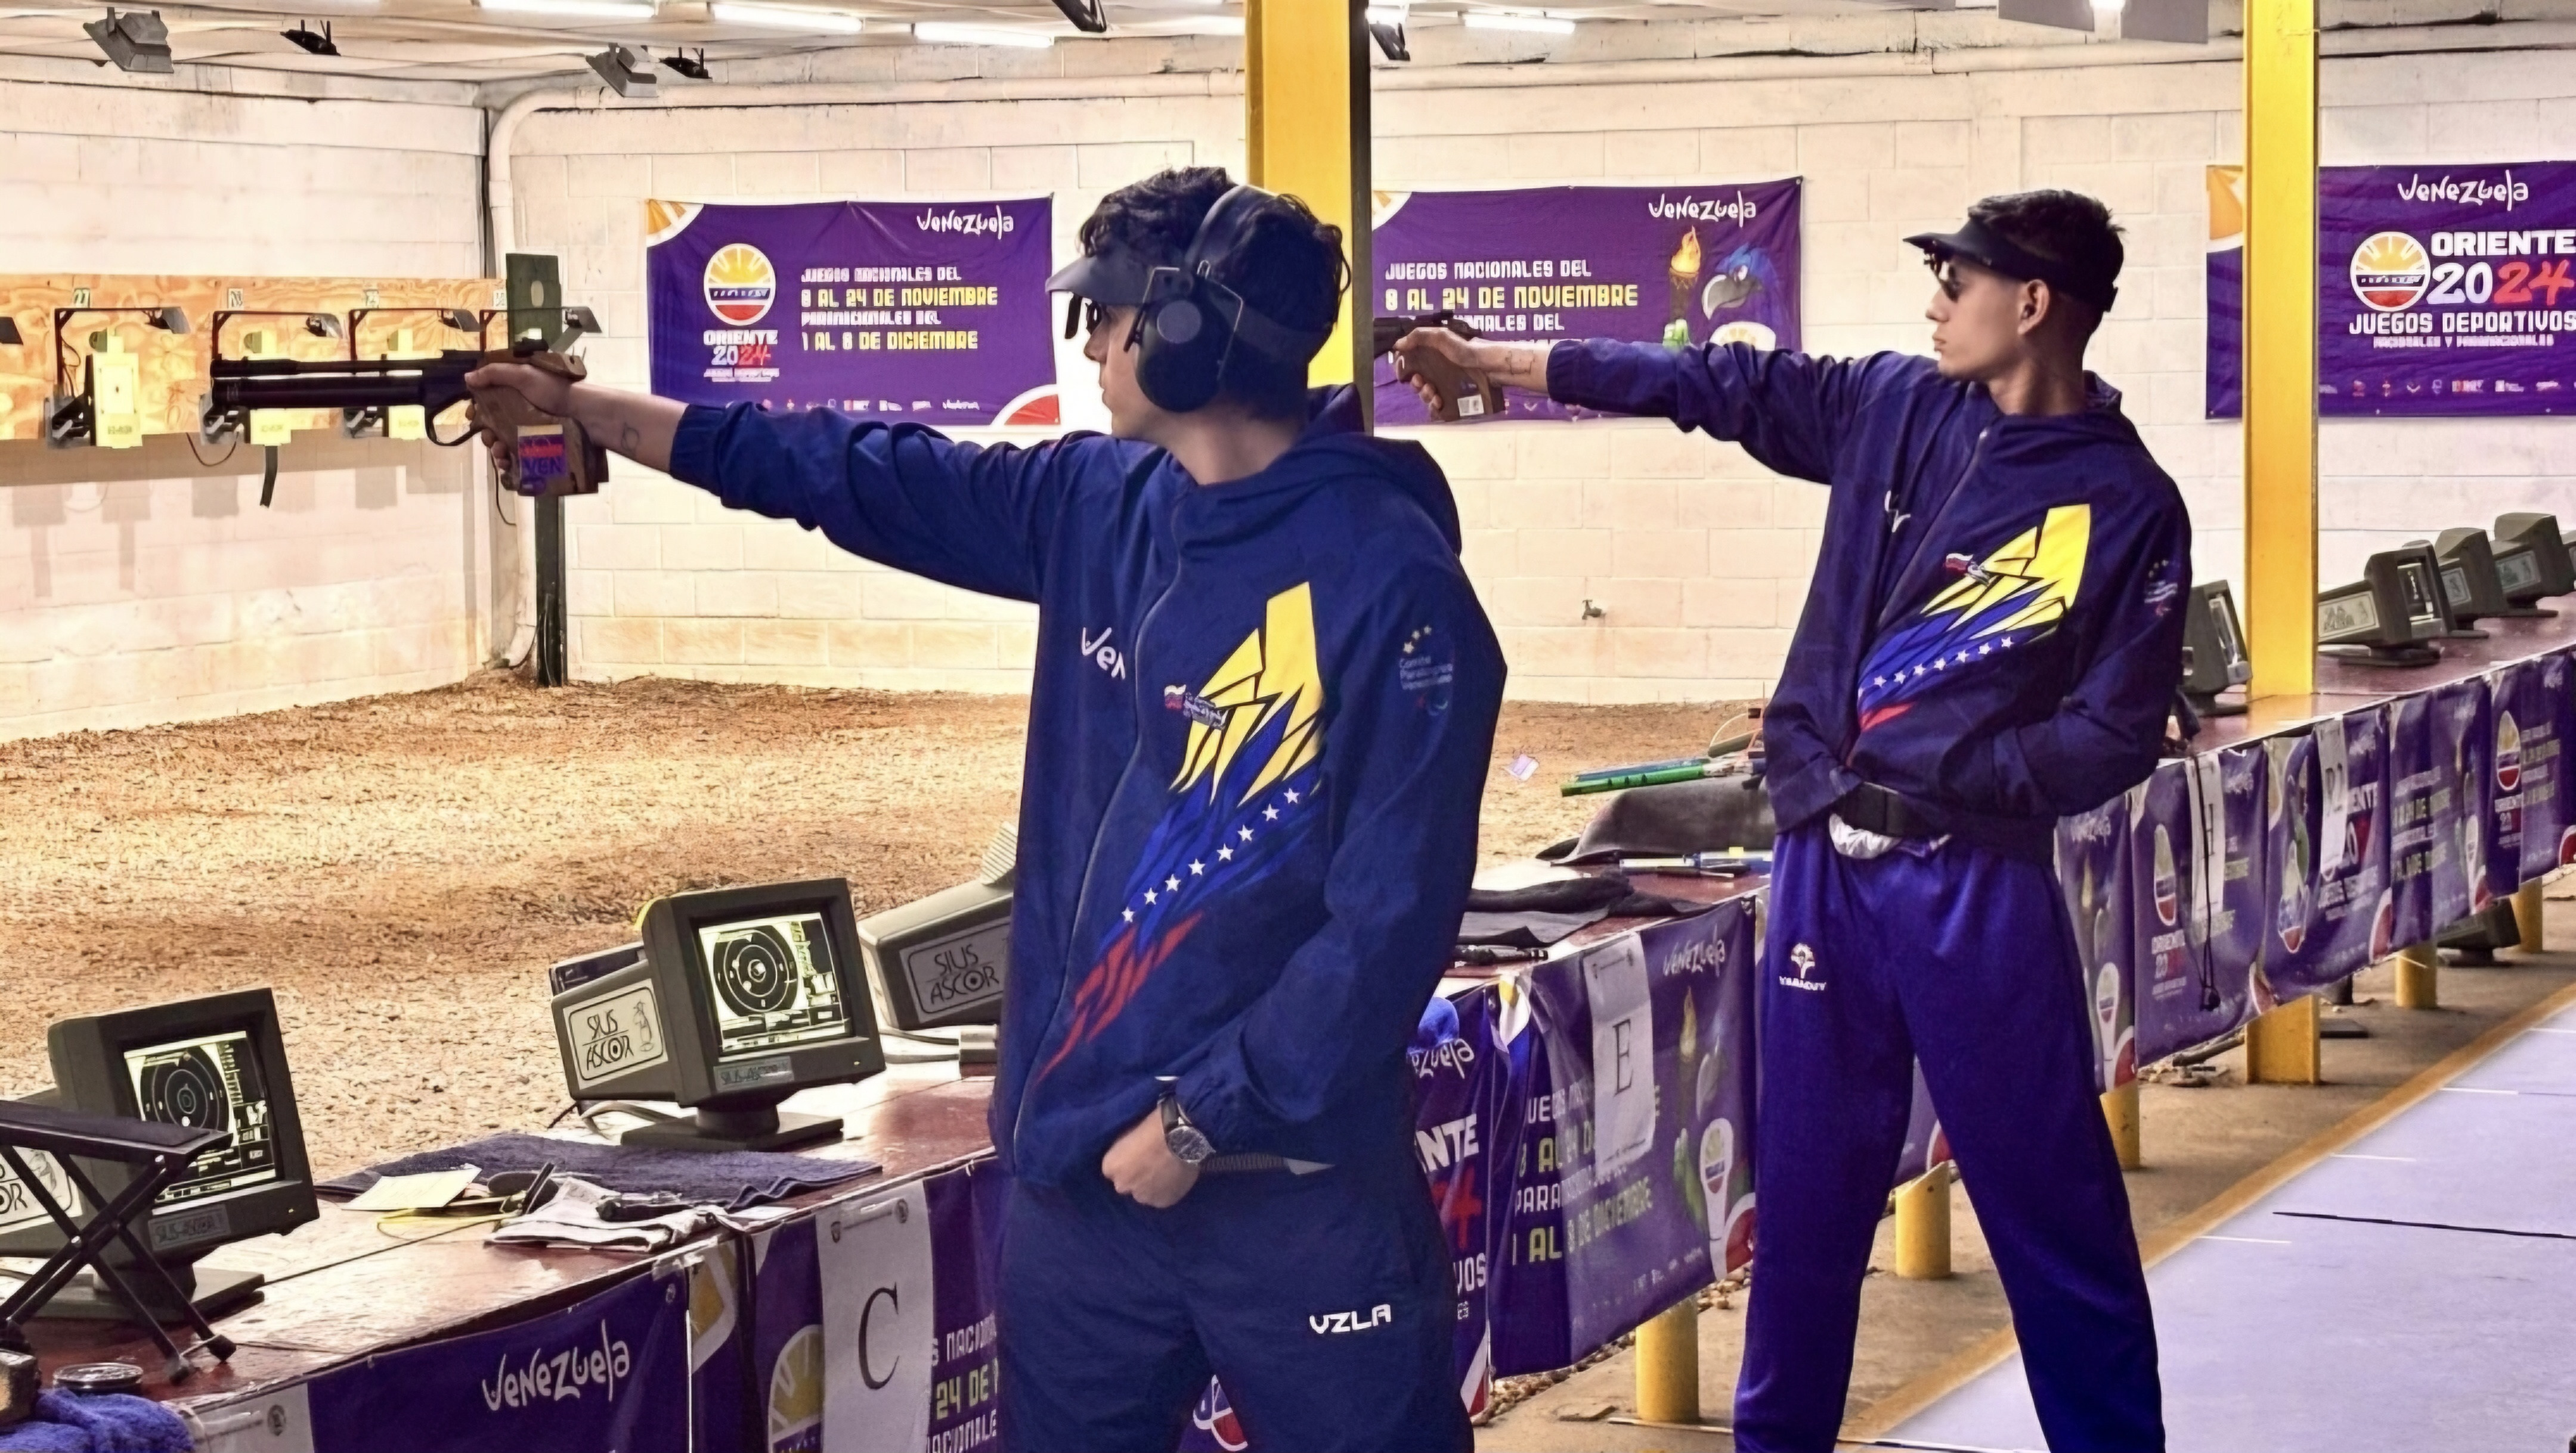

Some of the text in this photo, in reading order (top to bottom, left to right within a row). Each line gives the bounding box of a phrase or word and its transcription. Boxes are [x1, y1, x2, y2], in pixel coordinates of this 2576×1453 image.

[2431, 230, 2576, 256] ORIENTE
[937, 267, 962, 280] DEL
[1385, 259, 1592, 280] JUEGOS NACIONALES DEL
[2426, 259, 2575, 306] 2024
[818, 289, 839, 307] AL
[846, 289, 866, 307] 24
[873, 289, 894, 307] DE
[902, 287, 998, 306] NOVIEMBRE
[1385, 285, 1638, 311] 8 AL 24 DE NOVIEMBRE
[1533, 313, 1565, 331] DEL
[2349, 310, 2576, 335] JUEGOS DEPORTIVOS
[815, 332, 835, 351] AL
[859, 332, 881, 350] DE
[887, 331, 978, 350] DICIEMBRE
[711, 345, 772, 366] 2024
[934, 944, 979, 976] SIUS
[931, 966, 999, 1004] ASCOR
[1613, 1018, 1634, 1096] E
[1529, 1226, 1563, 1263] AL
[1309, 1304, 1392, 1334] VZLA
[859, 1282, 900, 1390] C
[936, 1364, 989, 1420] 24 DE
